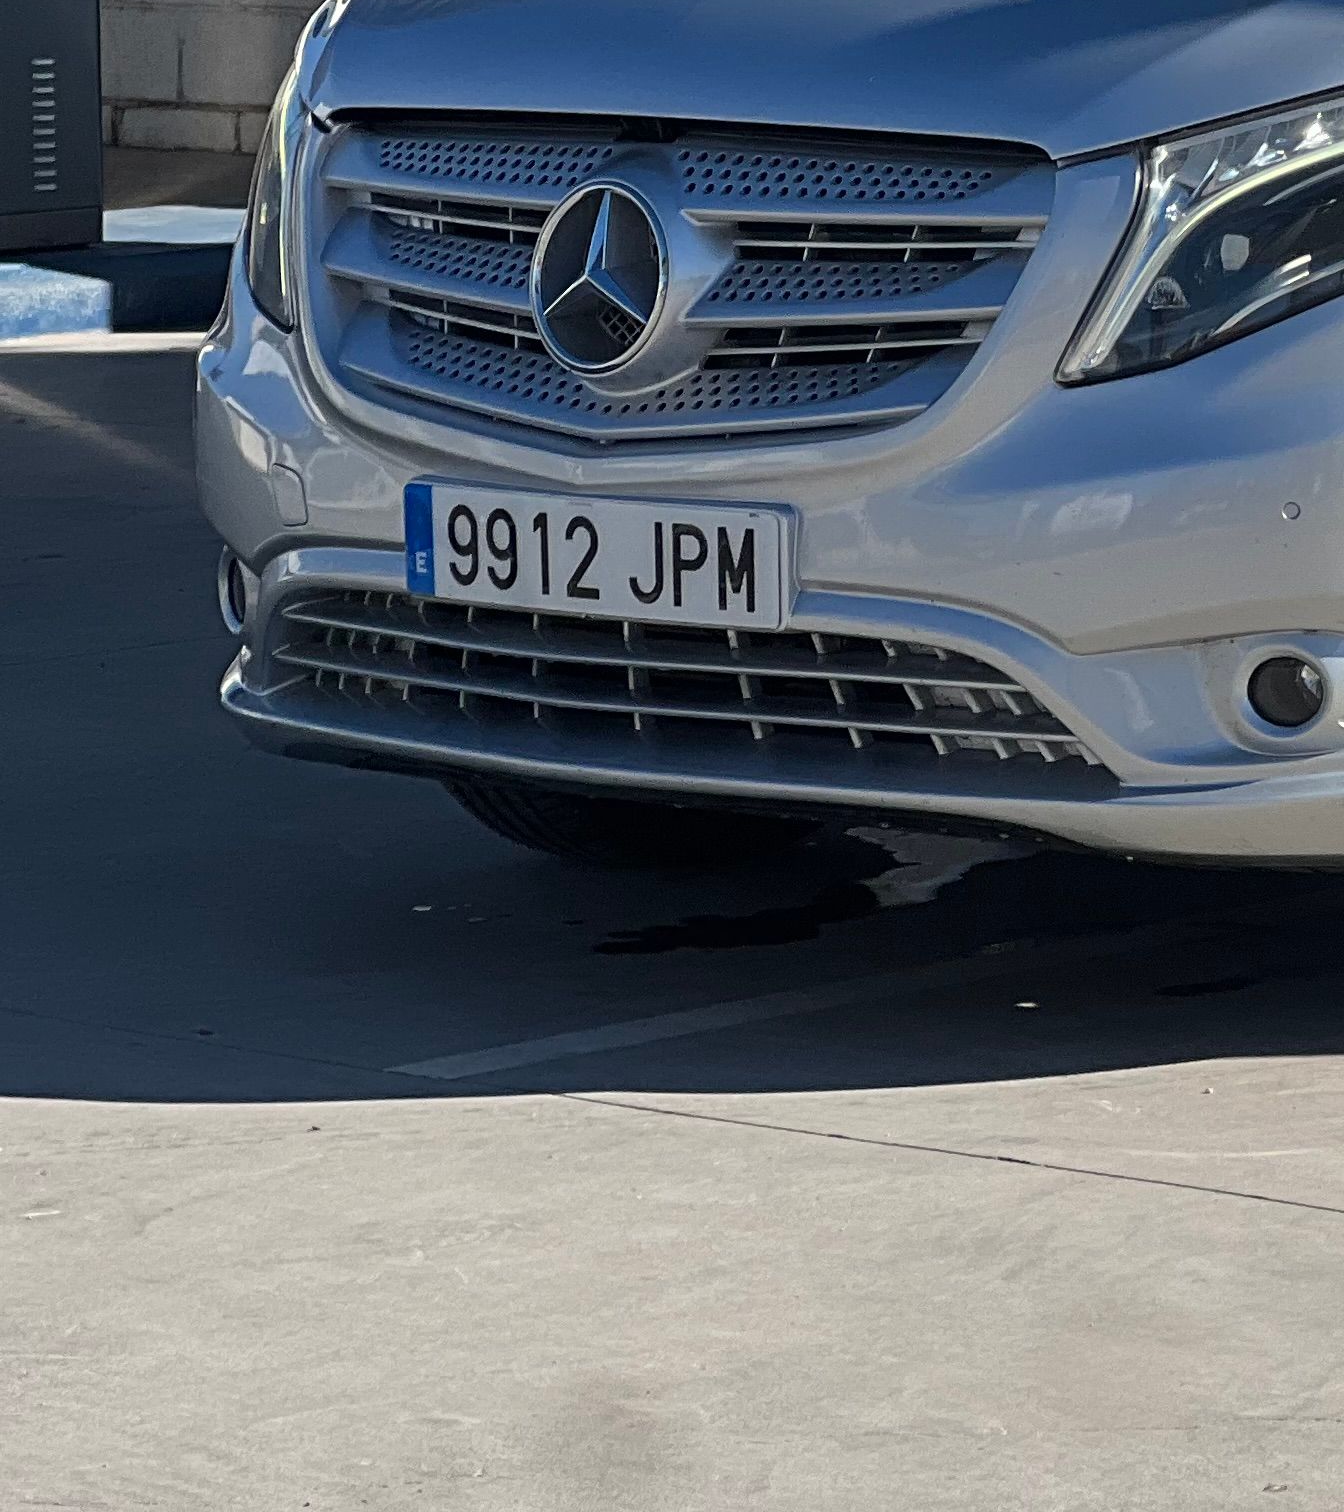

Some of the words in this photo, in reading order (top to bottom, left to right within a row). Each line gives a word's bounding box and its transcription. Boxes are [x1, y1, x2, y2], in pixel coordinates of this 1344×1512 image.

[415, 551, 428, 574] E
[447, 503, 601, 601] 9912
[628, 520, 756, 614] JPM
